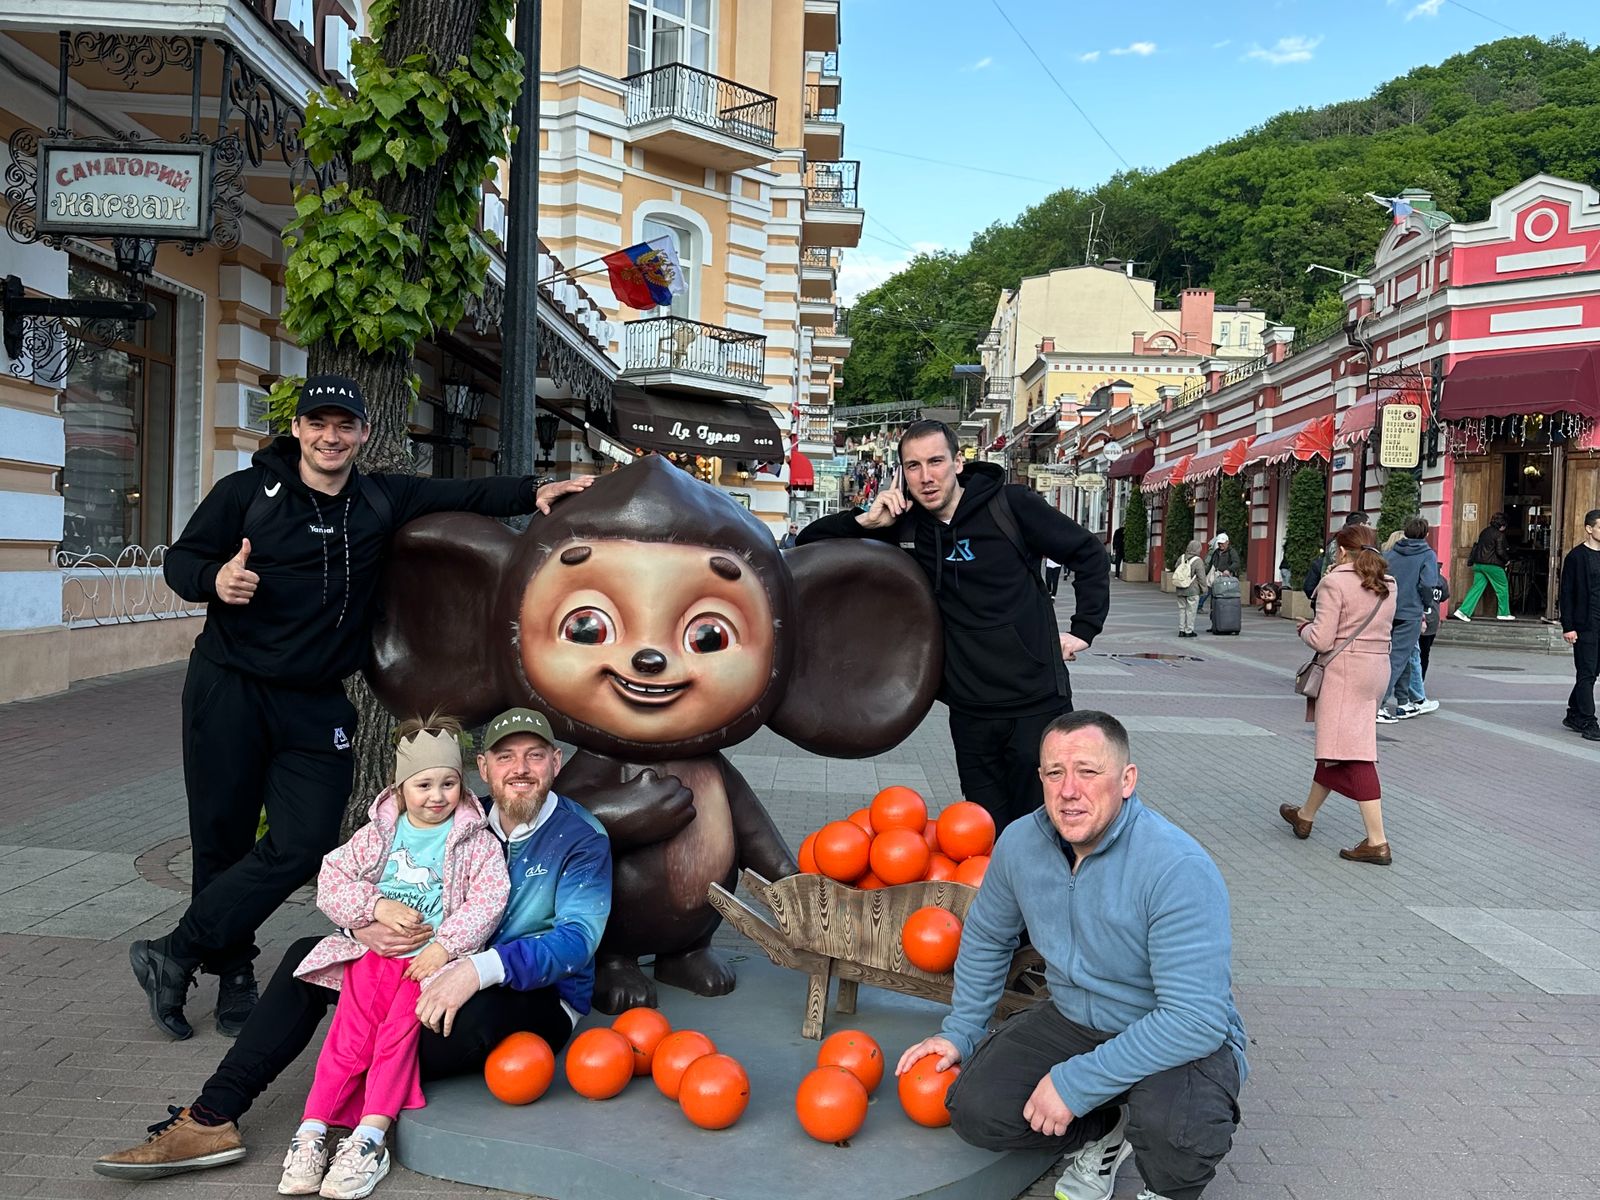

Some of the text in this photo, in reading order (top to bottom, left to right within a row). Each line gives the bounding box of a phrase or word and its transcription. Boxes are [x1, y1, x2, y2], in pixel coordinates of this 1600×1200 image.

[55, 157, 193, 193] САНАТОРИЙ
[309, 387, 354, 398] YAMAL
[494, 716, 541, 730] YAMAL
